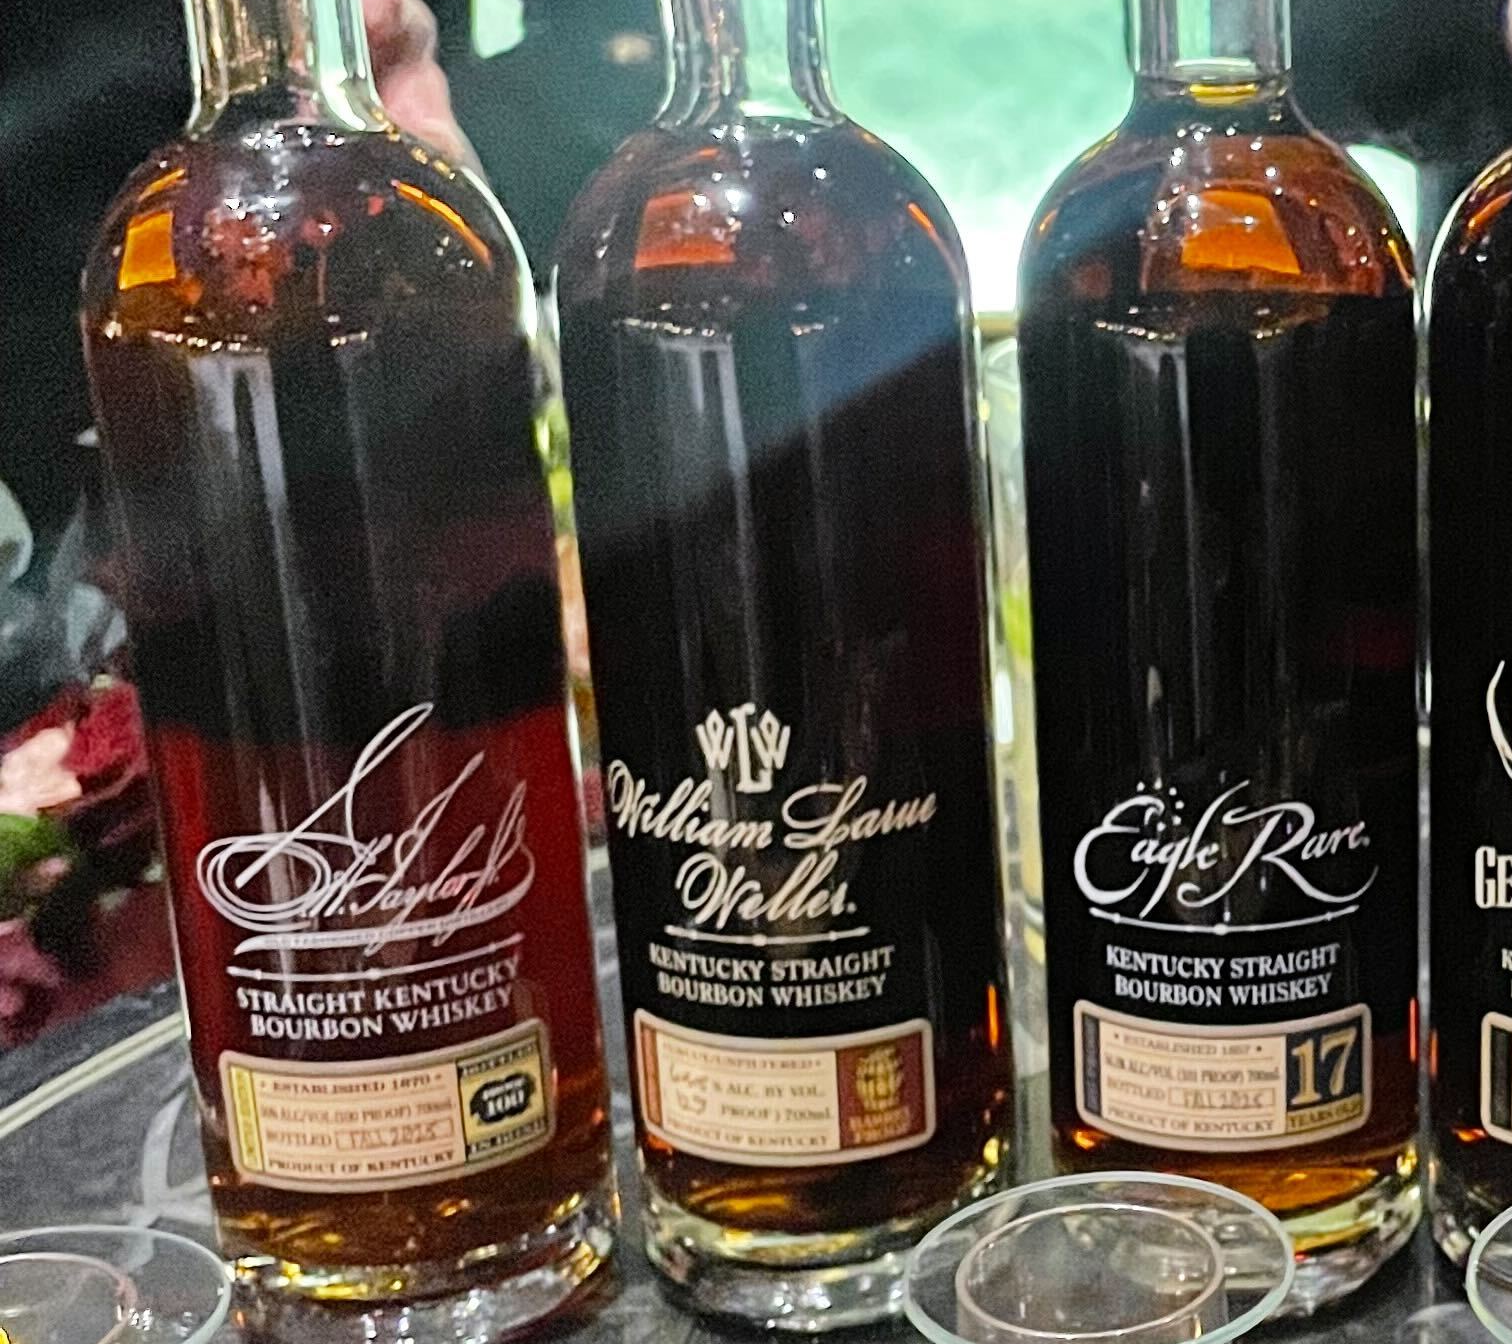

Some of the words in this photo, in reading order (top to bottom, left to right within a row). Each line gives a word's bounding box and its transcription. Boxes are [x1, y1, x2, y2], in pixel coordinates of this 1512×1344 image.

[608, 758, 774, 850] William
[1074, 779, 1250, 920] Eagle
[650, 942, 764, 982] KENTUCKY
[771, 944, 896, 982] STRAIGHT
[1106, 944, 1224, 980] KENTUCKY
[1230, 942, 1342, 981] STRAIGHT
[236, 986, 365, 1015] STRAIGHT
[373, 949, 520, 1011] KENTUCKY
[658, 971, 764, 1008] BOURBON
[771, 972, 887, 1008] WHISKEY
[1115, 973, 1223, 1007] BOURBON
[1229, 972, 1333, 1007] WHISKEY
[250, 1013, 384, 1040] BOURBON
[388, 985, 513, 1034] WHISKEY
[1291, 1026, 1358, 1106] 17
[1170, 1119, 1189, 1131] OF
[1193, 1119, 1276, 1134] KENTUCKY
[269, 1159, 335, 1173] PRODUCT
[341, 1163, 360, 1173] OF
[367, 1150, 455, 1172] KENTUCKY
